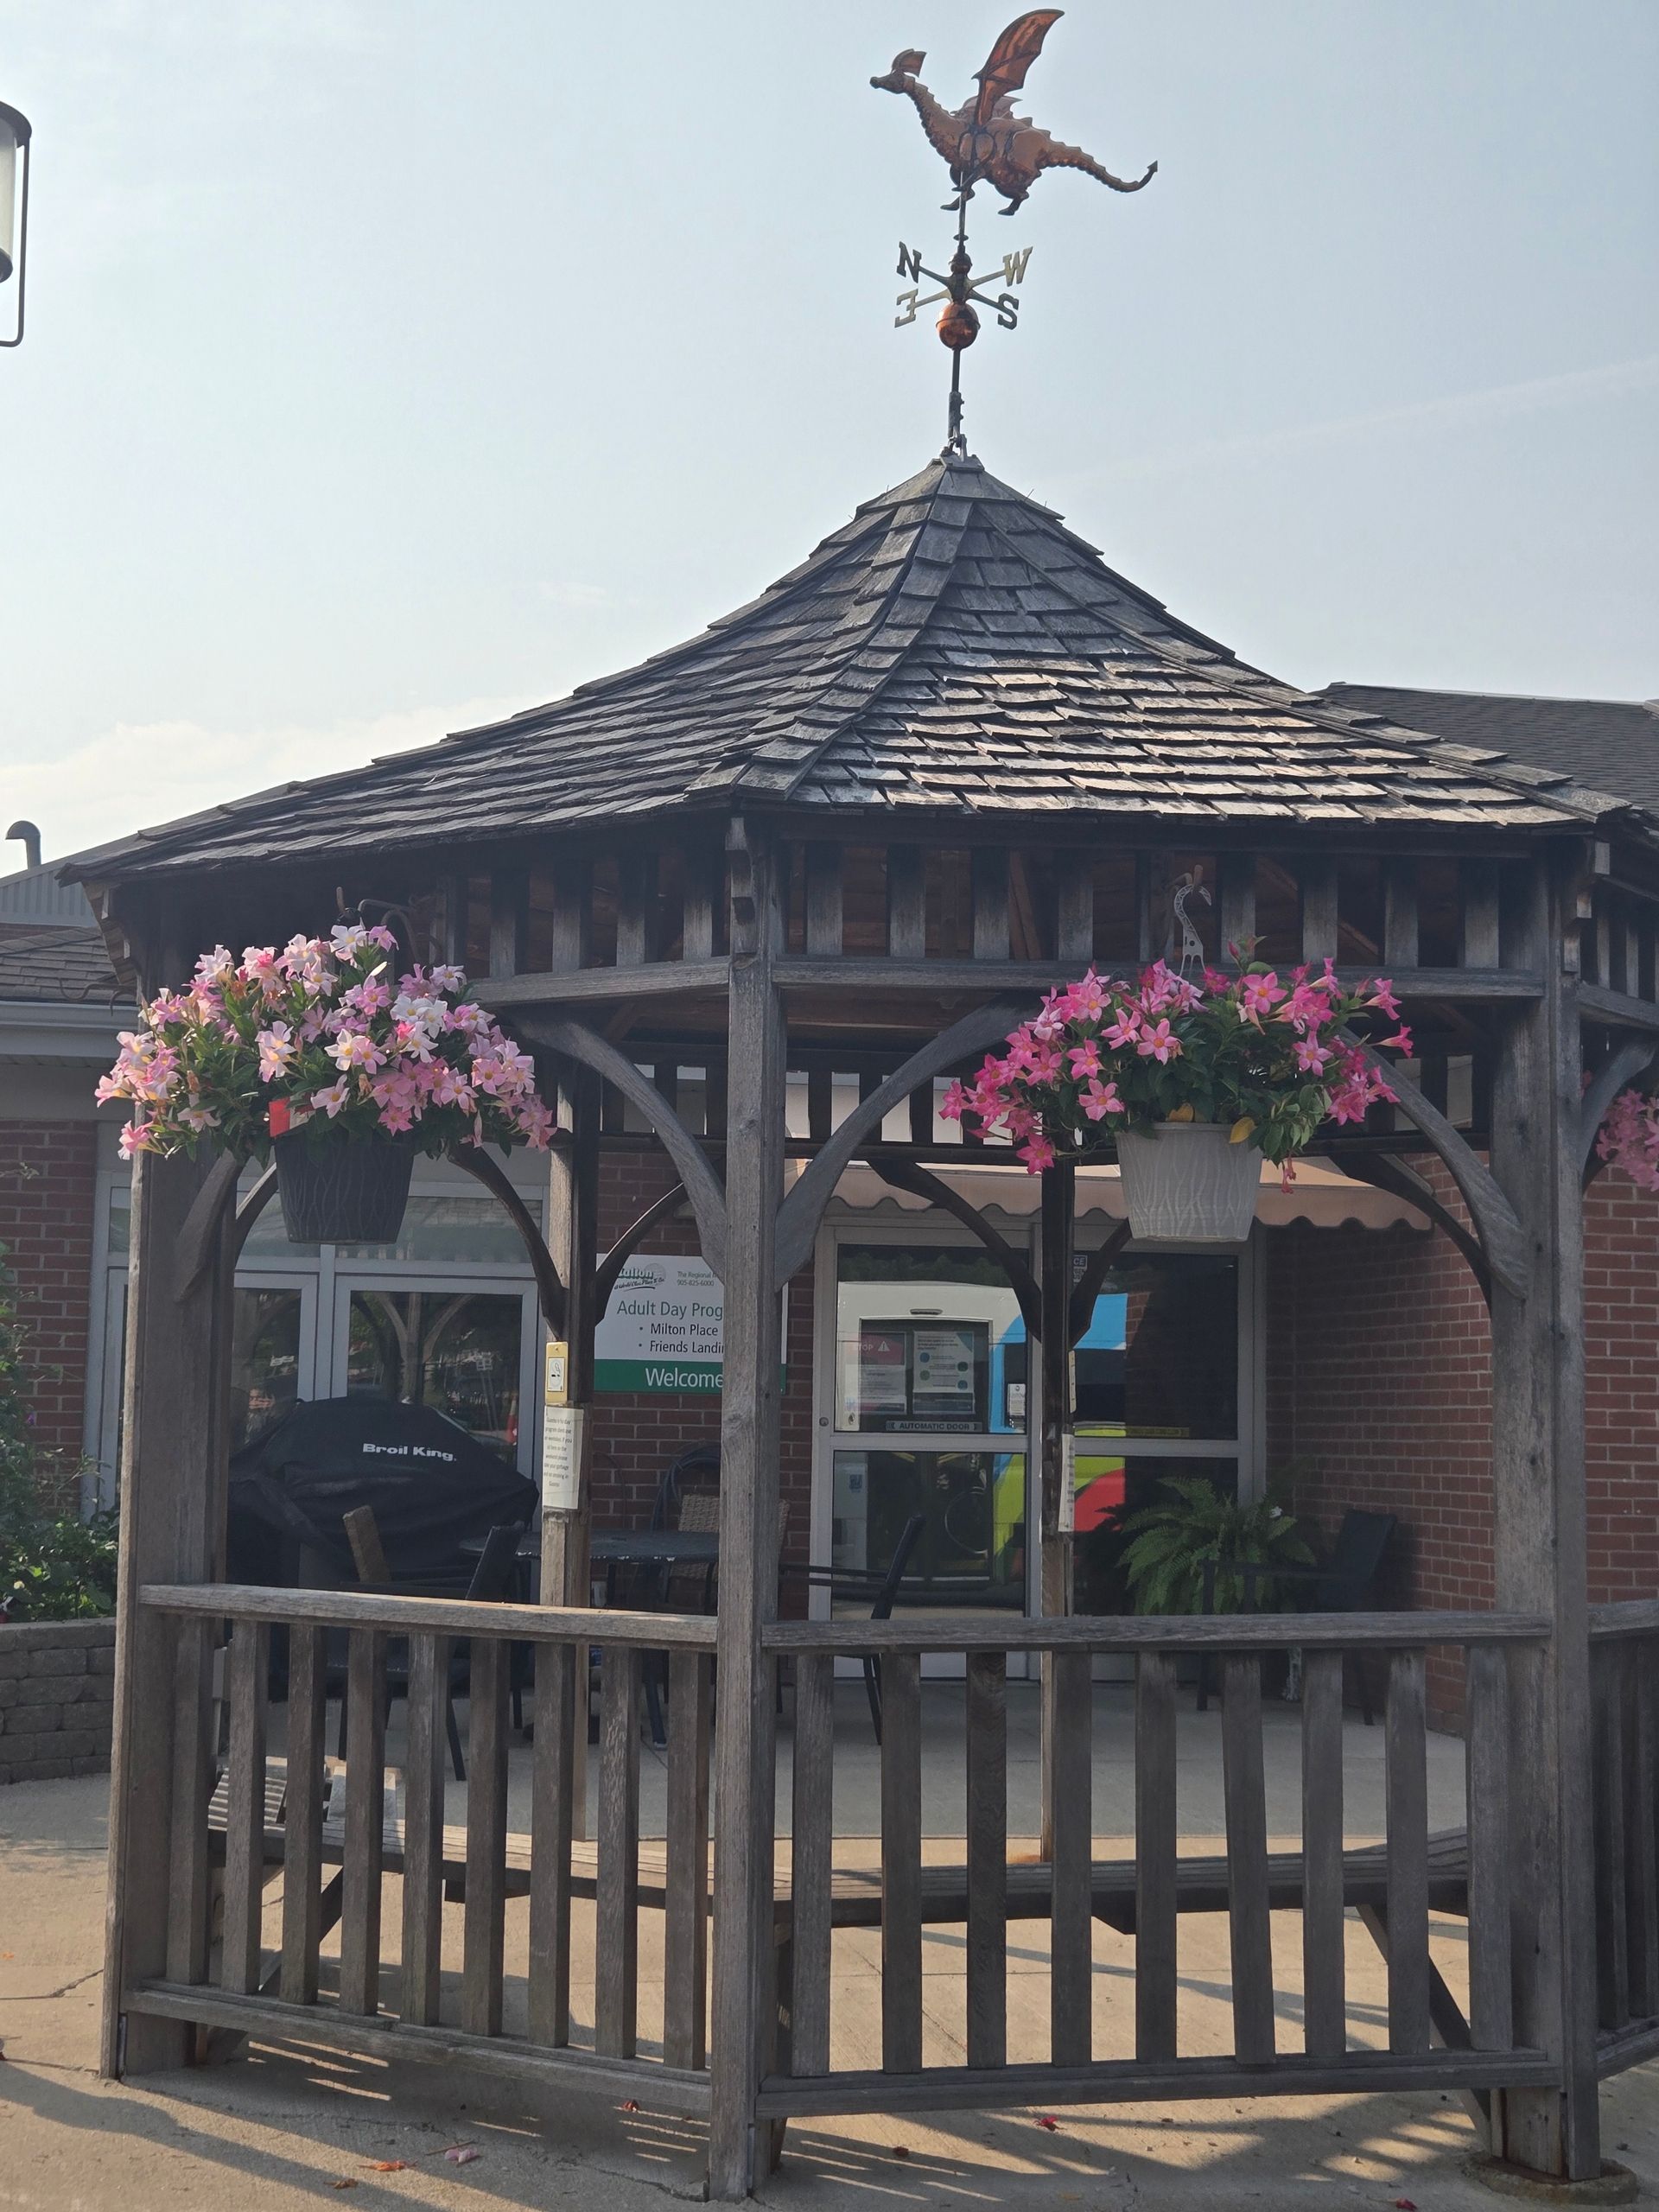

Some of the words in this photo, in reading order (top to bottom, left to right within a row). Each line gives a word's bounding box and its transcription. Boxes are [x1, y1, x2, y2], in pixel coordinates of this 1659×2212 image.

[896, 241, 922, 283] N
[1002, 246, 1033, 287] W
[997, 293, 1020, 330] S
[617, 1300, 656, 1315] Adult
[660, 1301, 687, 1320] Day
[691, 1302, 723, 1321] Prog
[651, 1323, 686, 1335] Milton
[690, 1324, 718, 1336] Place
[650, 1340, 688, 1353] Friends
[645, 1367, 723, 1388] Welcome
[363, 1443, 408, 1455] Broil
